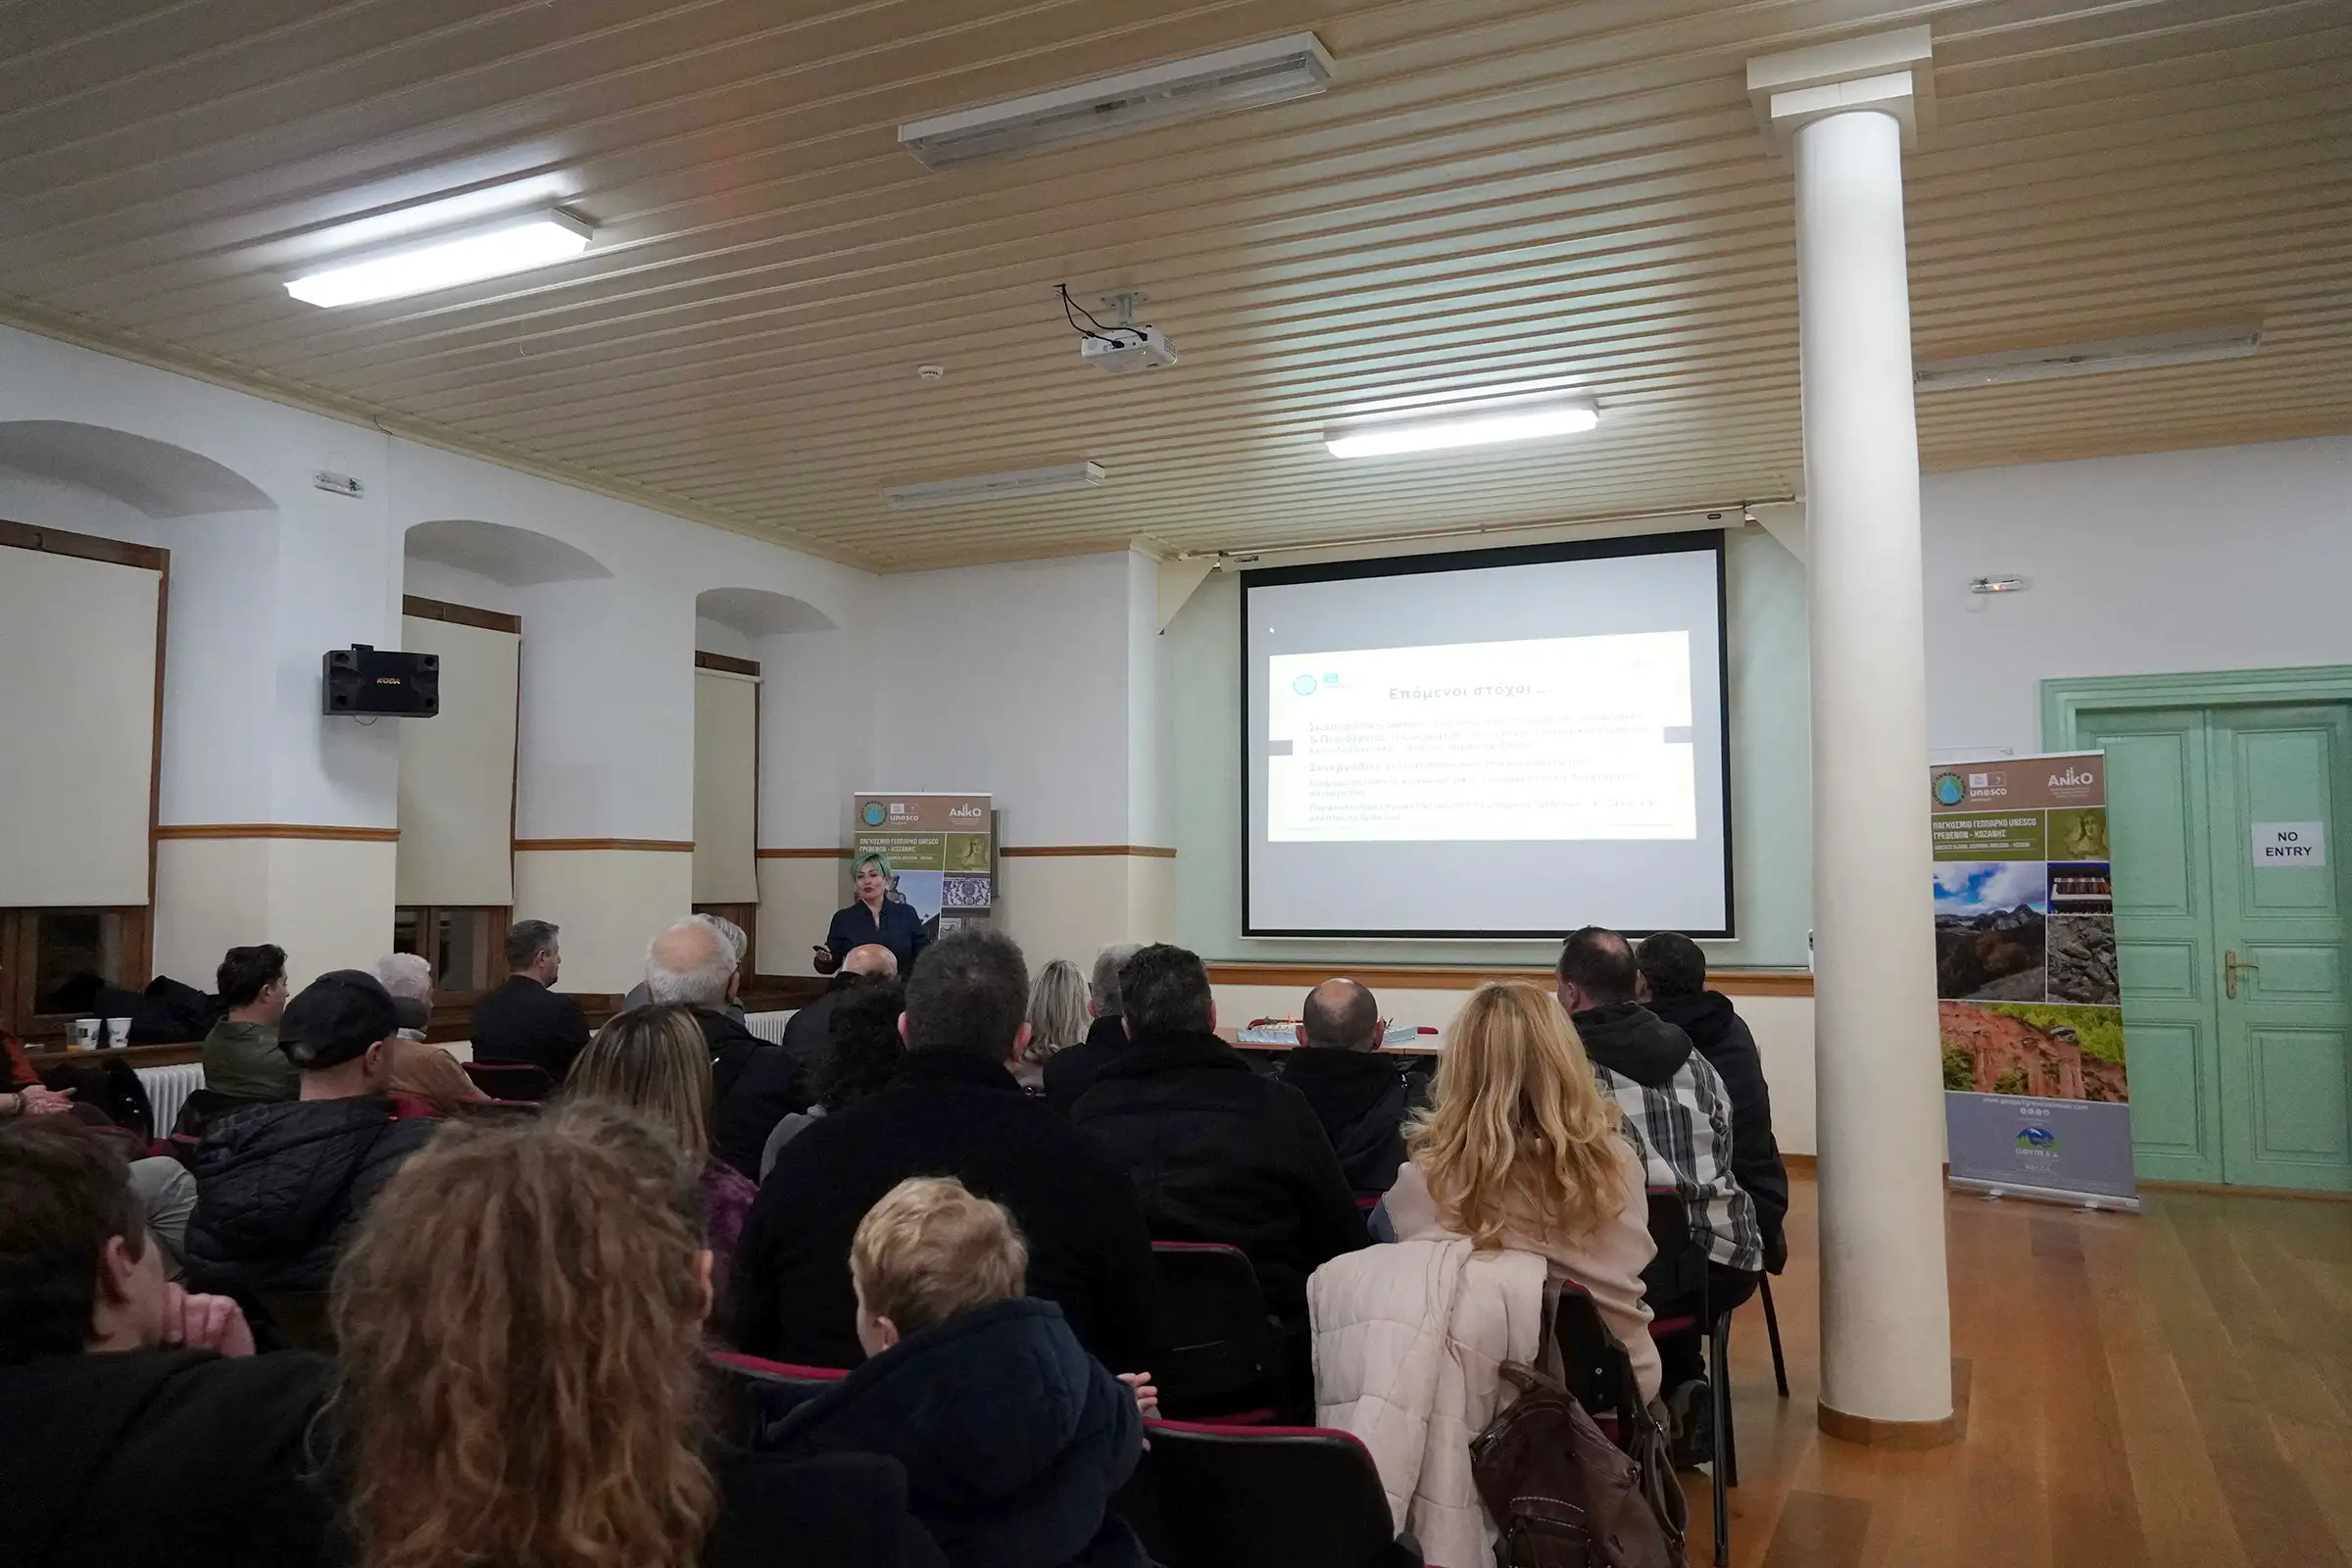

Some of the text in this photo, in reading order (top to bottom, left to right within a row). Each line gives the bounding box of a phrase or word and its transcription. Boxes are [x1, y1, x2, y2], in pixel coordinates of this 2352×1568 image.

[1389, 684, 1468, 701] Επόμενοι
[1473, 681, 1532, 698] στόχοι
[1969, 787, 2008, 797] unesco
[2278, 831, 2298, 842] NO
[2265, 846, 2313, 857] ENTRY
